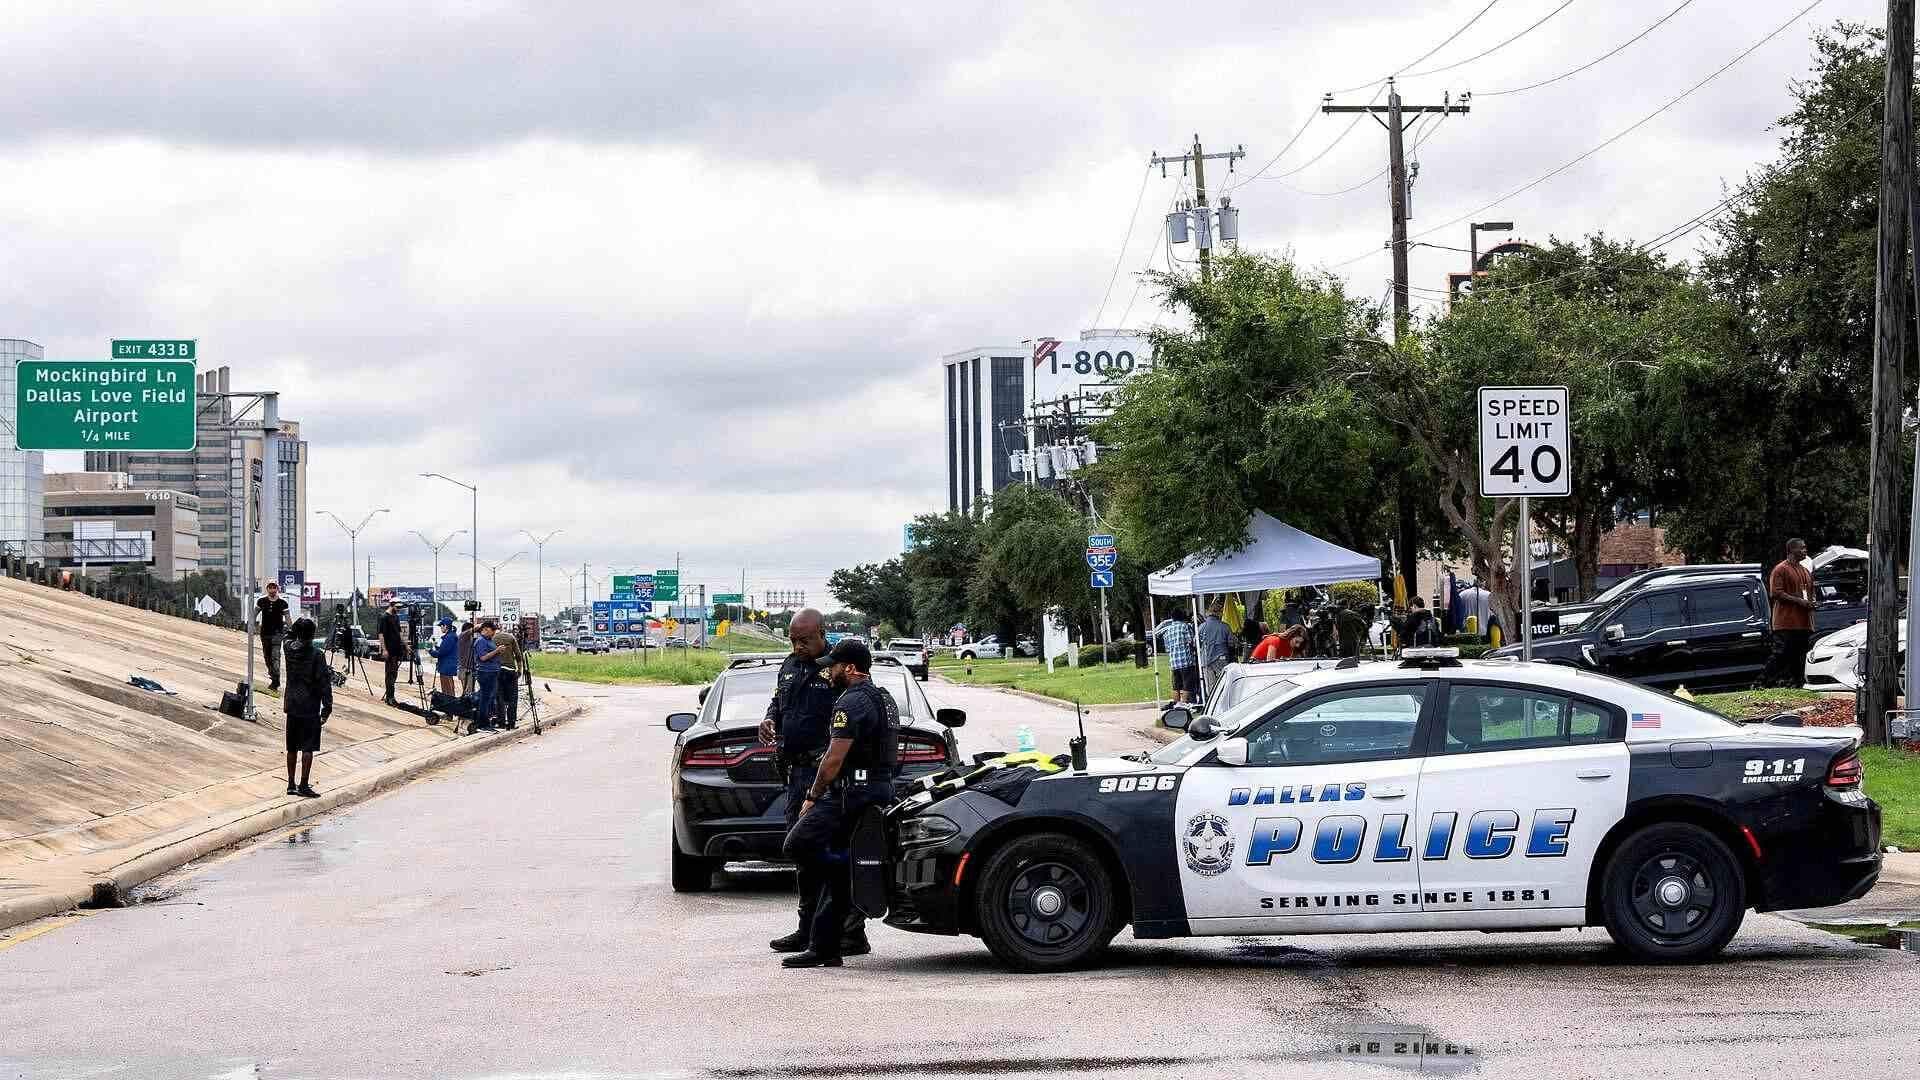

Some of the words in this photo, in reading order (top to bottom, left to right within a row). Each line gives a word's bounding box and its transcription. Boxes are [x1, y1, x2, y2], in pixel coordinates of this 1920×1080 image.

[119, 345, 142, 353] EXIT
[148, 343, 175, 355] 433
[179, 343, 188, 355] B
[36, 368, 147, 385] Mockingbird
[157, 369, 177, 382] Ln
[26, 389, 81, 402] Dallas
[91, 389, 132, 402] Love
[142, 389, 186, 402] Field
[1488, 399, 1560, 416] SPEED
[74, 409, 138, 425] Airport
[105, 431, 130, 440] MILE
[1496, 422, 1552, 439] LIMIT
[1490, 444, 1562, 483] 40
[1090, 538, 1112, 546] SOUTH
[1090, 554, 1112, 567] 35E
[304, 585, 317, 598] QT
[636, 588, 652, 598] 35E
[502, 613, 517, 622] 60
[1098, 775, 1177, 793] 9096
[1742, 775, 1802, 784] EMERGENCY
[1228, 782, 1367, 806] DALLAS
[1189, 815, 1228, 827] POLICE
[1245, 808, 1577, 867] POLICE
[1260, 894, 1379, 909] SERVING
[1393, 891, 1473, 905] SINCE
[1487, 889, 1550, 902] 1881
